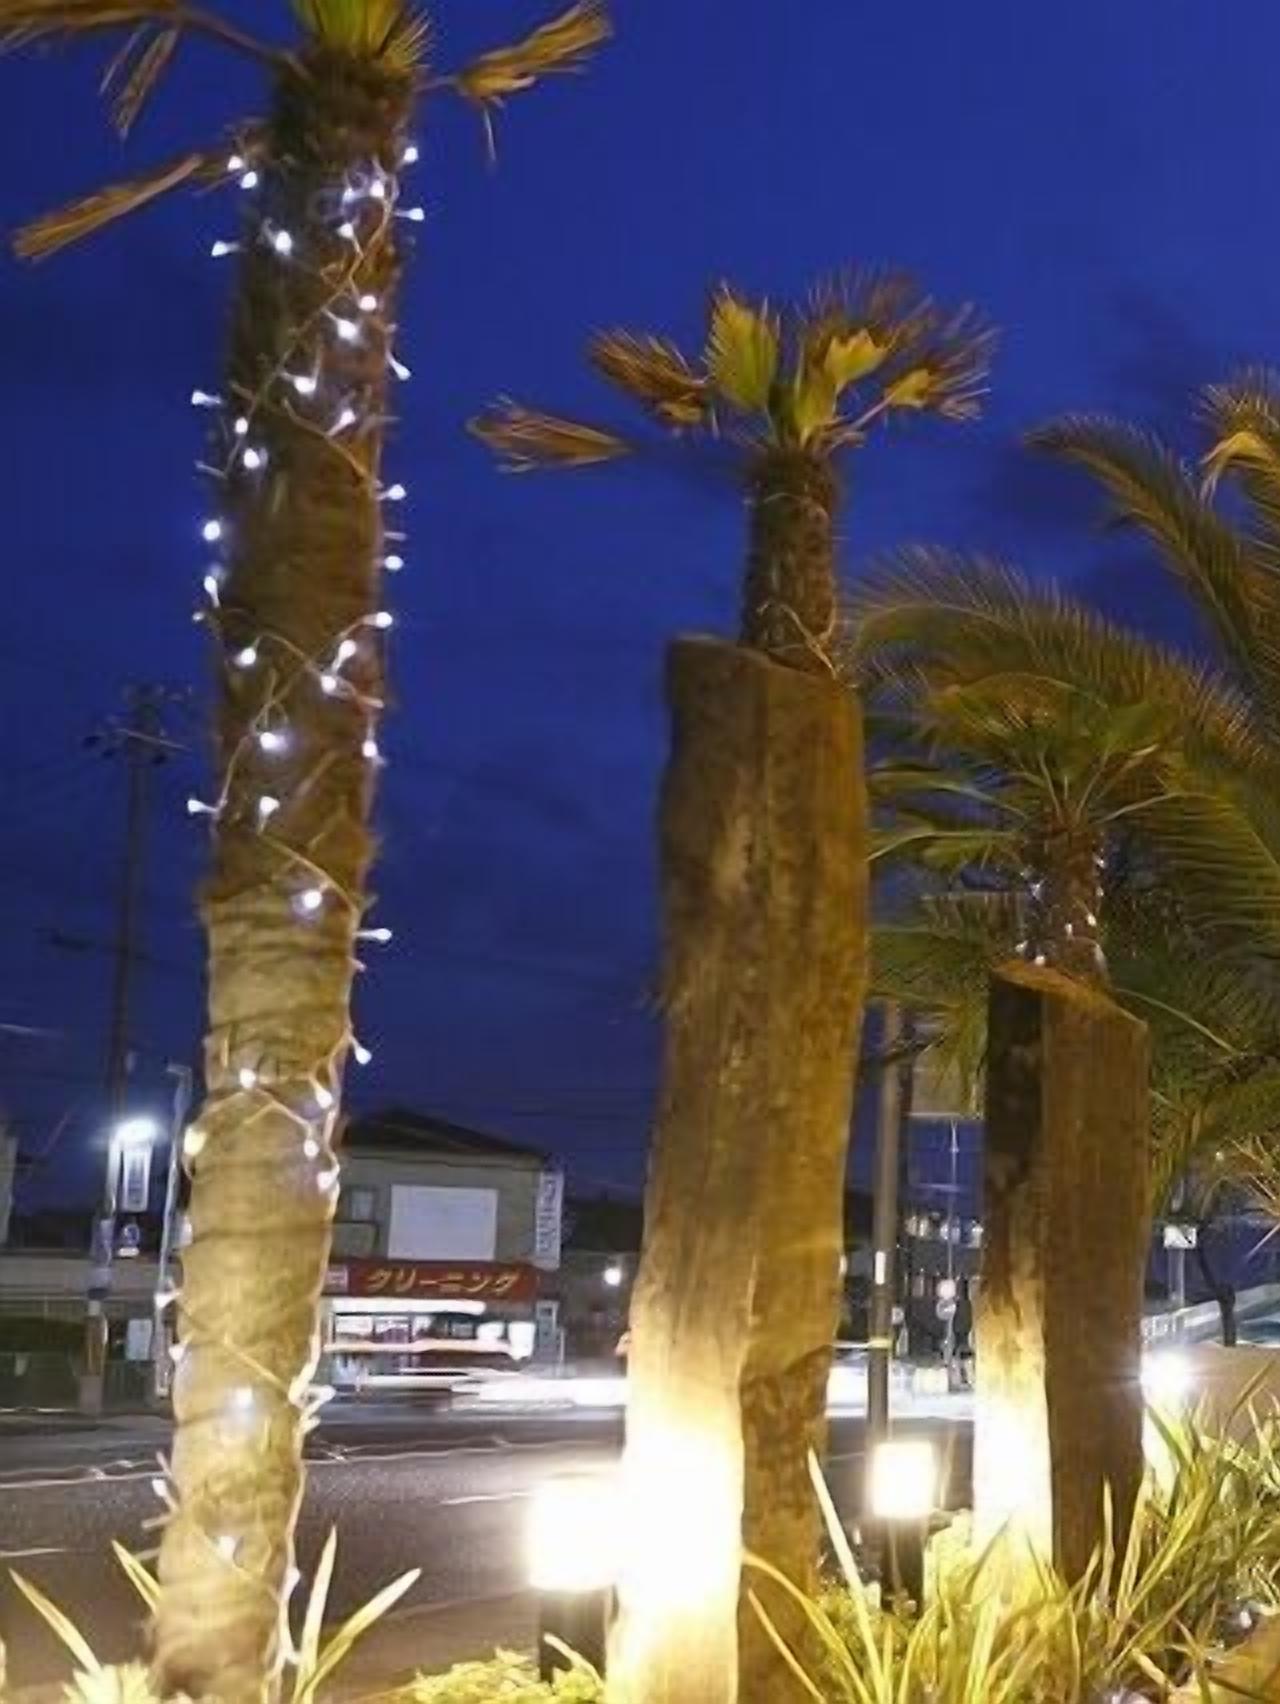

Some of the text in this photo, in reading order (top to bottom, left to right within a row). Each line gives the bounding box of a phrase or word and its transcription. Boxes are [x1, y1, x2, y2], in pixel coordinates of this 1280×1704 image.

[367, 1267, 519, 1295] クリーニング
